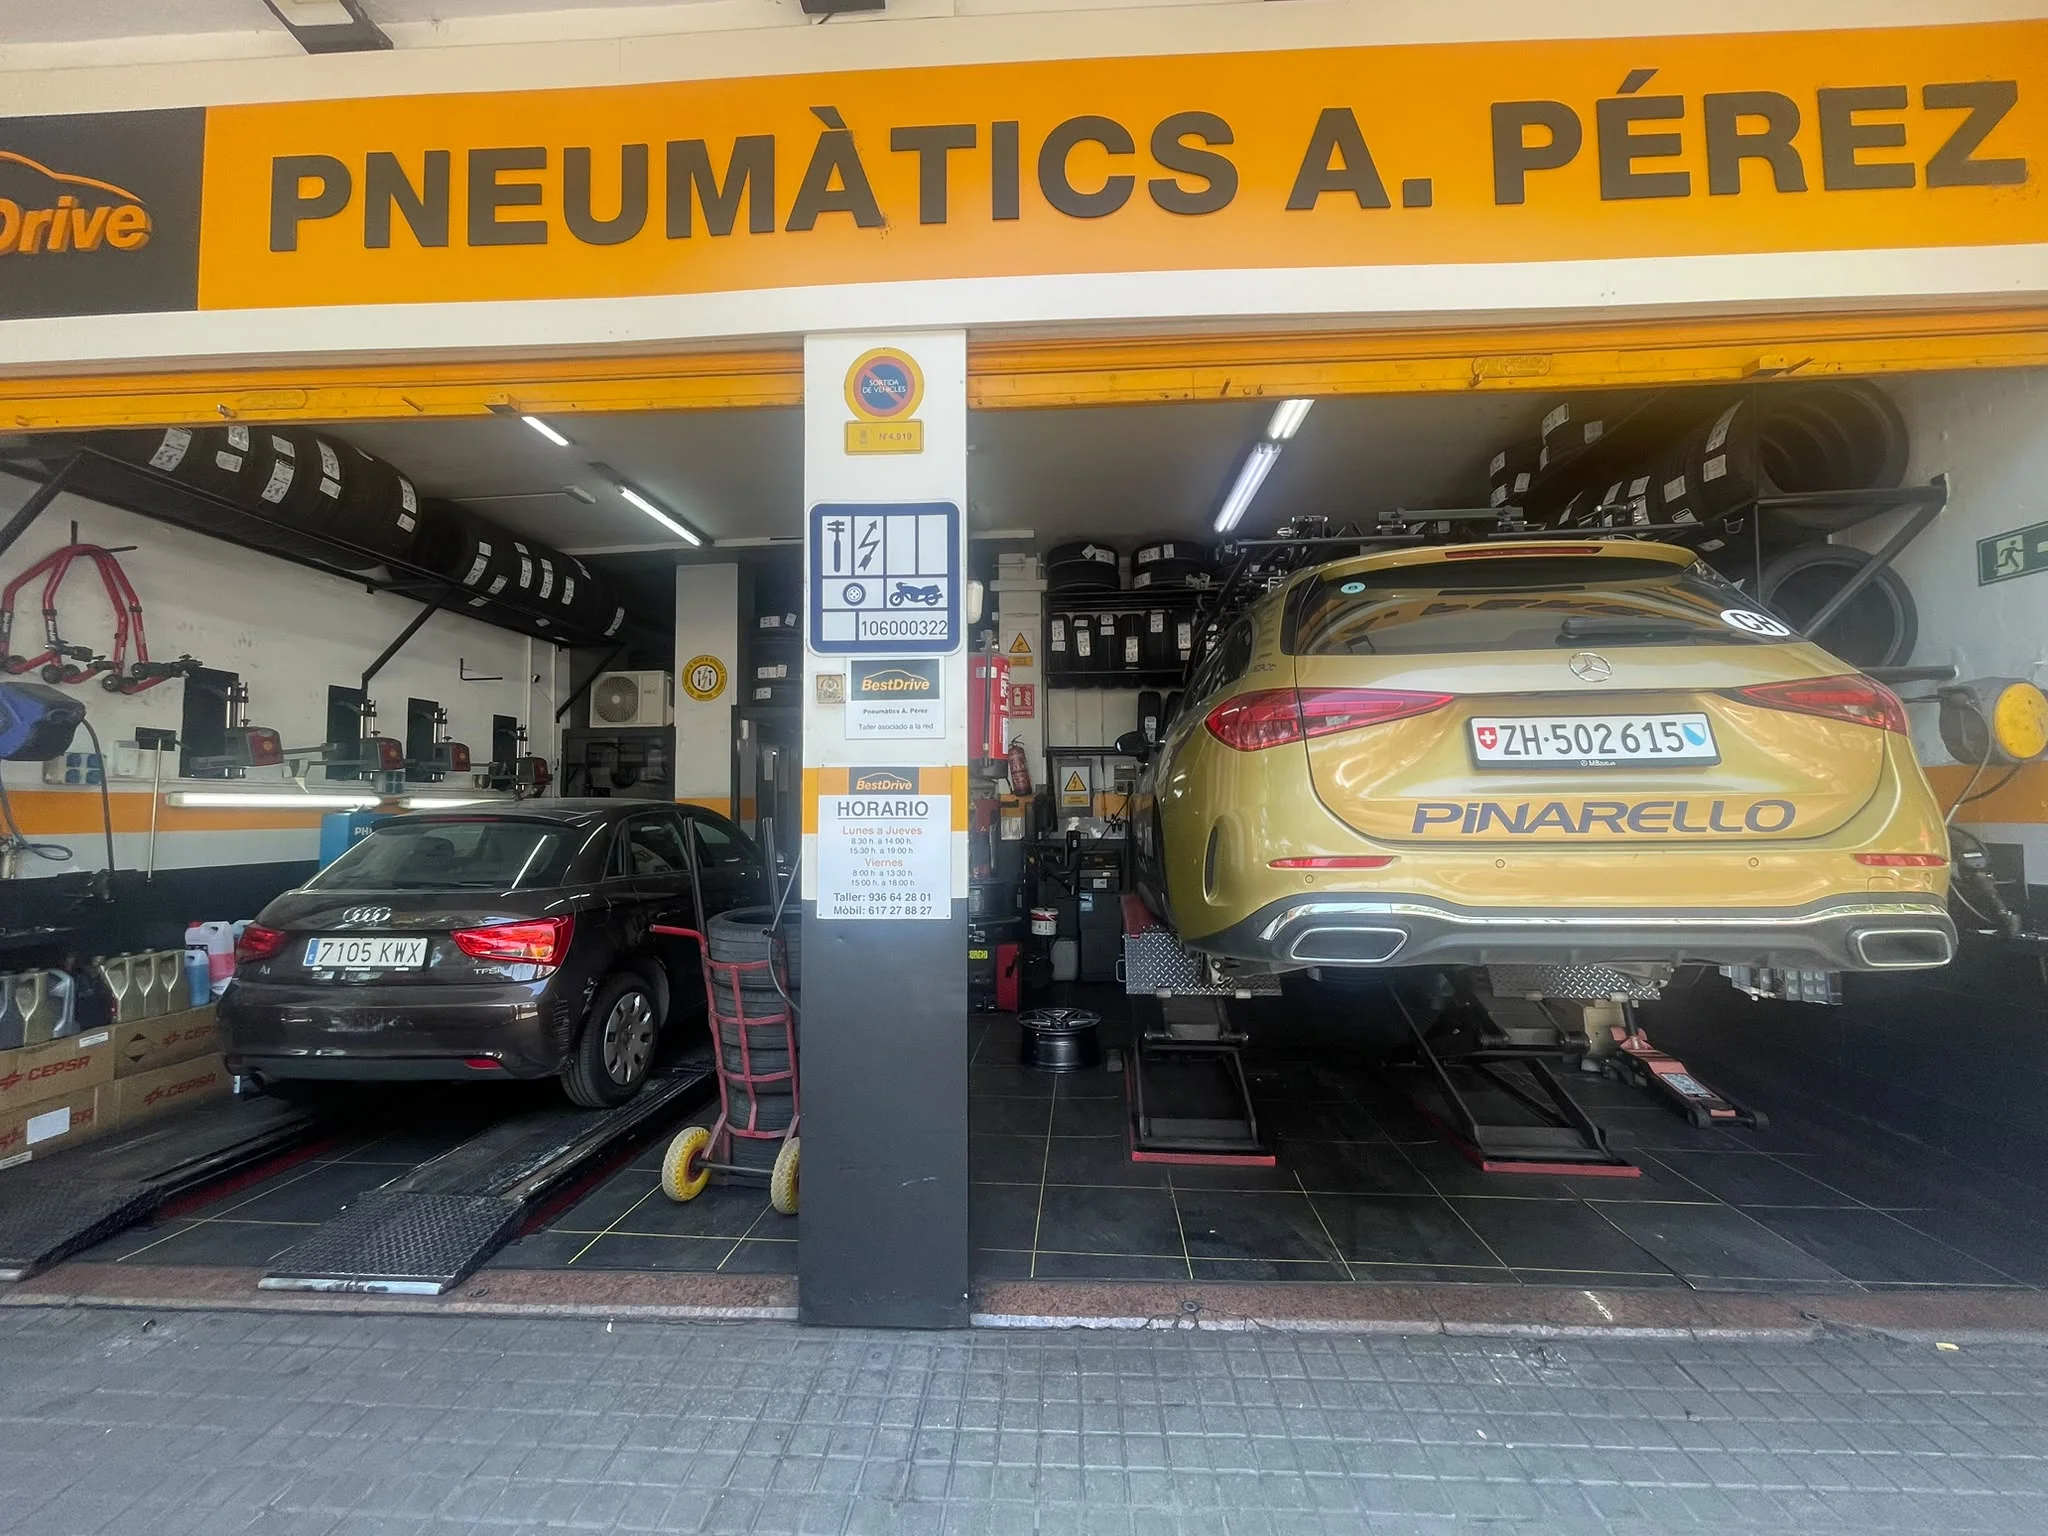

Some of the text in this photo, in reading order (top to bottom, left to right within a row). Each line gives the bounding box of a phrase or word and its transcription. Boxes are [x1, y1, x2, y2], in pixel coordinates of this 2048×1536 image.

[268, 68, 2030, 253] PNEUMÀTICS A. PÉREZ
[869, 379, 899, 387] SORTIDA
[862, 385, 907, 394] DE VEHICLES
[861, 620, 948, 637] 106000322
[1729, 611, 1787, 634] CH
[861, 678, 931, 691] BestDrive
[858, 723, 877, 731] Taller
[878, 722, 908, 730] asociado
[915, 722, 921, 730] la
[922, 722, 934, 730] red
[855, 779, 913, 791] BestDrive
[837, 800, 929, 817] HORARIO
[842, 826, 922, 836] Lunes a Jueves
[864, 857, 903, 867] Viernes
[833, 892, 932, 902] Taller: 936 64 28 01
[833, 905, 933, 915] Mòbil: 617 27 88 27
[318, 941, 422, 963] 7105 KWX
[28, 1055, 92, 1082] CEPSA
